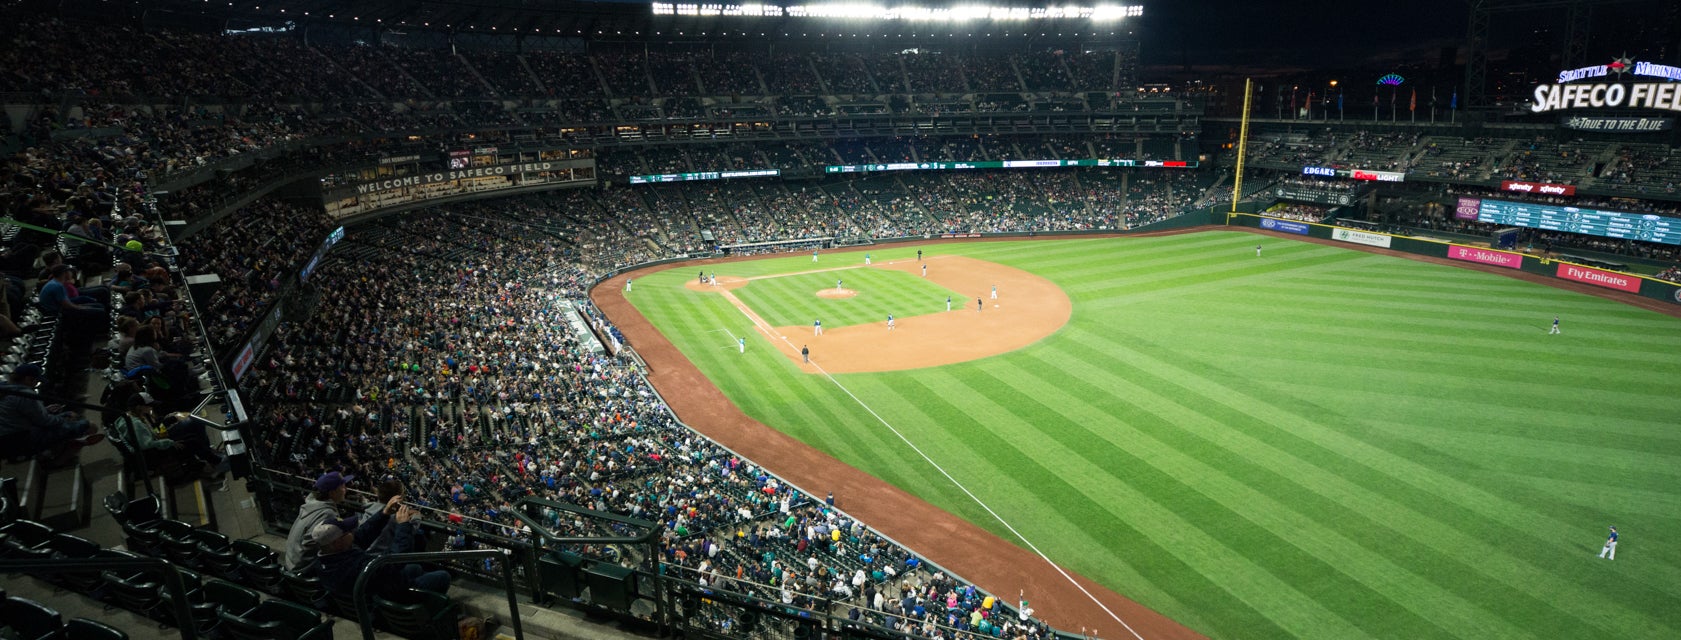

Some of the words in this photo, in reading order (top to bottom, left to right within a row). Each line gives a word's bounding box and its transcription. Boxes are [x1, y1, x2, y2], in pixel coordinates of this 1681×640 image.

[1558, 65, 1608, 83] SEATTLE
[1531, 83, 1626, 113] SAFECO
[1579, 117, 1603, 129] TRUE
[1604, 119, 1617, 130] TO
[1617, 119, 1637, 130] THE
[1636, 118, 1665, 130] BLUE
[357, 176, 421, 194] WELCOME
[424, 173, 443, 183] TO
[449, 166, 504, 180] SAFECO
[510, 162, 551, 173] FIELD
[1376, 174, 1399, 182] LIGHT
[1508, 183, 1533, 192] xfinity
[1539, 185, 1566, 195] xfinity
[1568, 267, 1584, 279] Fly
[1585, 271, 1628, 287] Emirates
